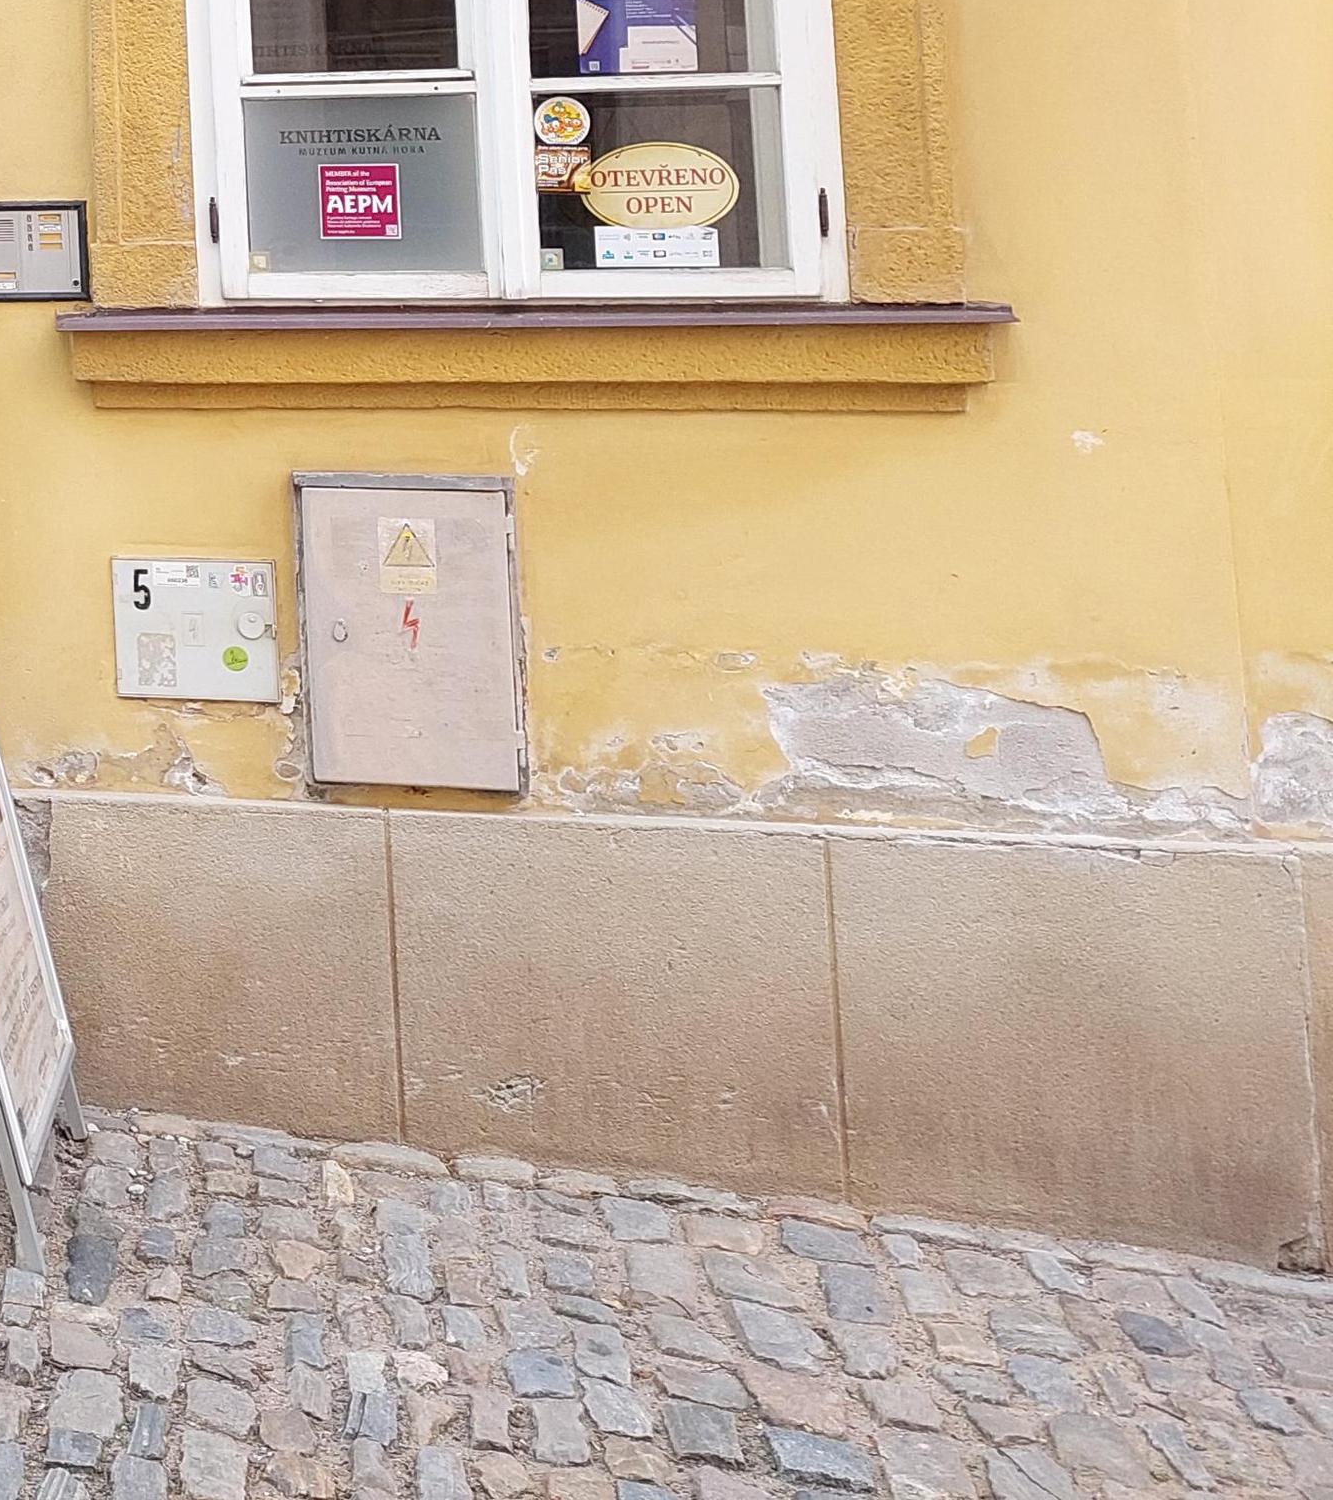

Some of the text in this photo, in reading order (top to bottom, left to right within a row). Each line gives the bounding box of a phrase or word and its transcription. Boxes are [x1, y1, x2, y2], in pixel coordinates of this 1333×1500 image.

[280, 124, 441, 144] KNIHTISKÁRNA
[299, 147, 347, 156] MUZEUM
[538, 153, 587, 164] Senior
[538, 164, 566, 175] Pas
[590, 163, 726, 188] OTEVŘENO
[326, 194, 393, 213] AEPM
[626, 196, 693, 214] OPEN
[134, 569, 151, 610] 5
